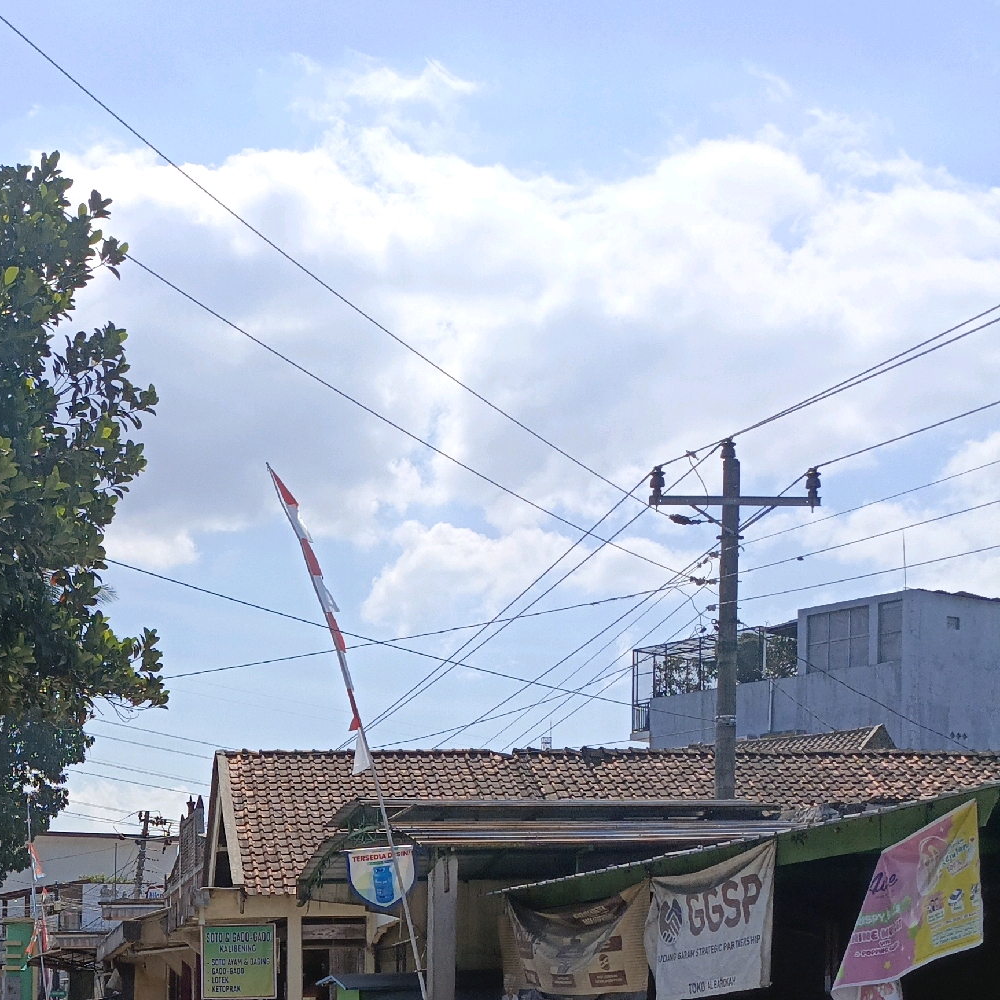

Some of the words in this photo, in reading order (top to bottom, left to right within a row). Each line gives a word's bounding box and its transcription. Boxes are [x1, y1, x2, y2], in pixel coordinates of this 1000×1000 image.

[686, 874, 762, 936] GGSP
[206, 932, 223, 943] SOTO
[225, 932, 230, 943] &
[233, 931, 271, 943] GADO-GADO
[723, 934, 761, 952] PARTNERSHIP
[219, 944, 257, 953] KALIBENING
[211, 958, 226, 966] SOTO
[228, 958, 242, 966] AYAM
[211, 967, 245, 975] GADO-GADO
[211, 976, 229, 984] LOTEK
[211, 985, 241, 993] KETOPRAK
[688, 982, 706, 994] TOKO
